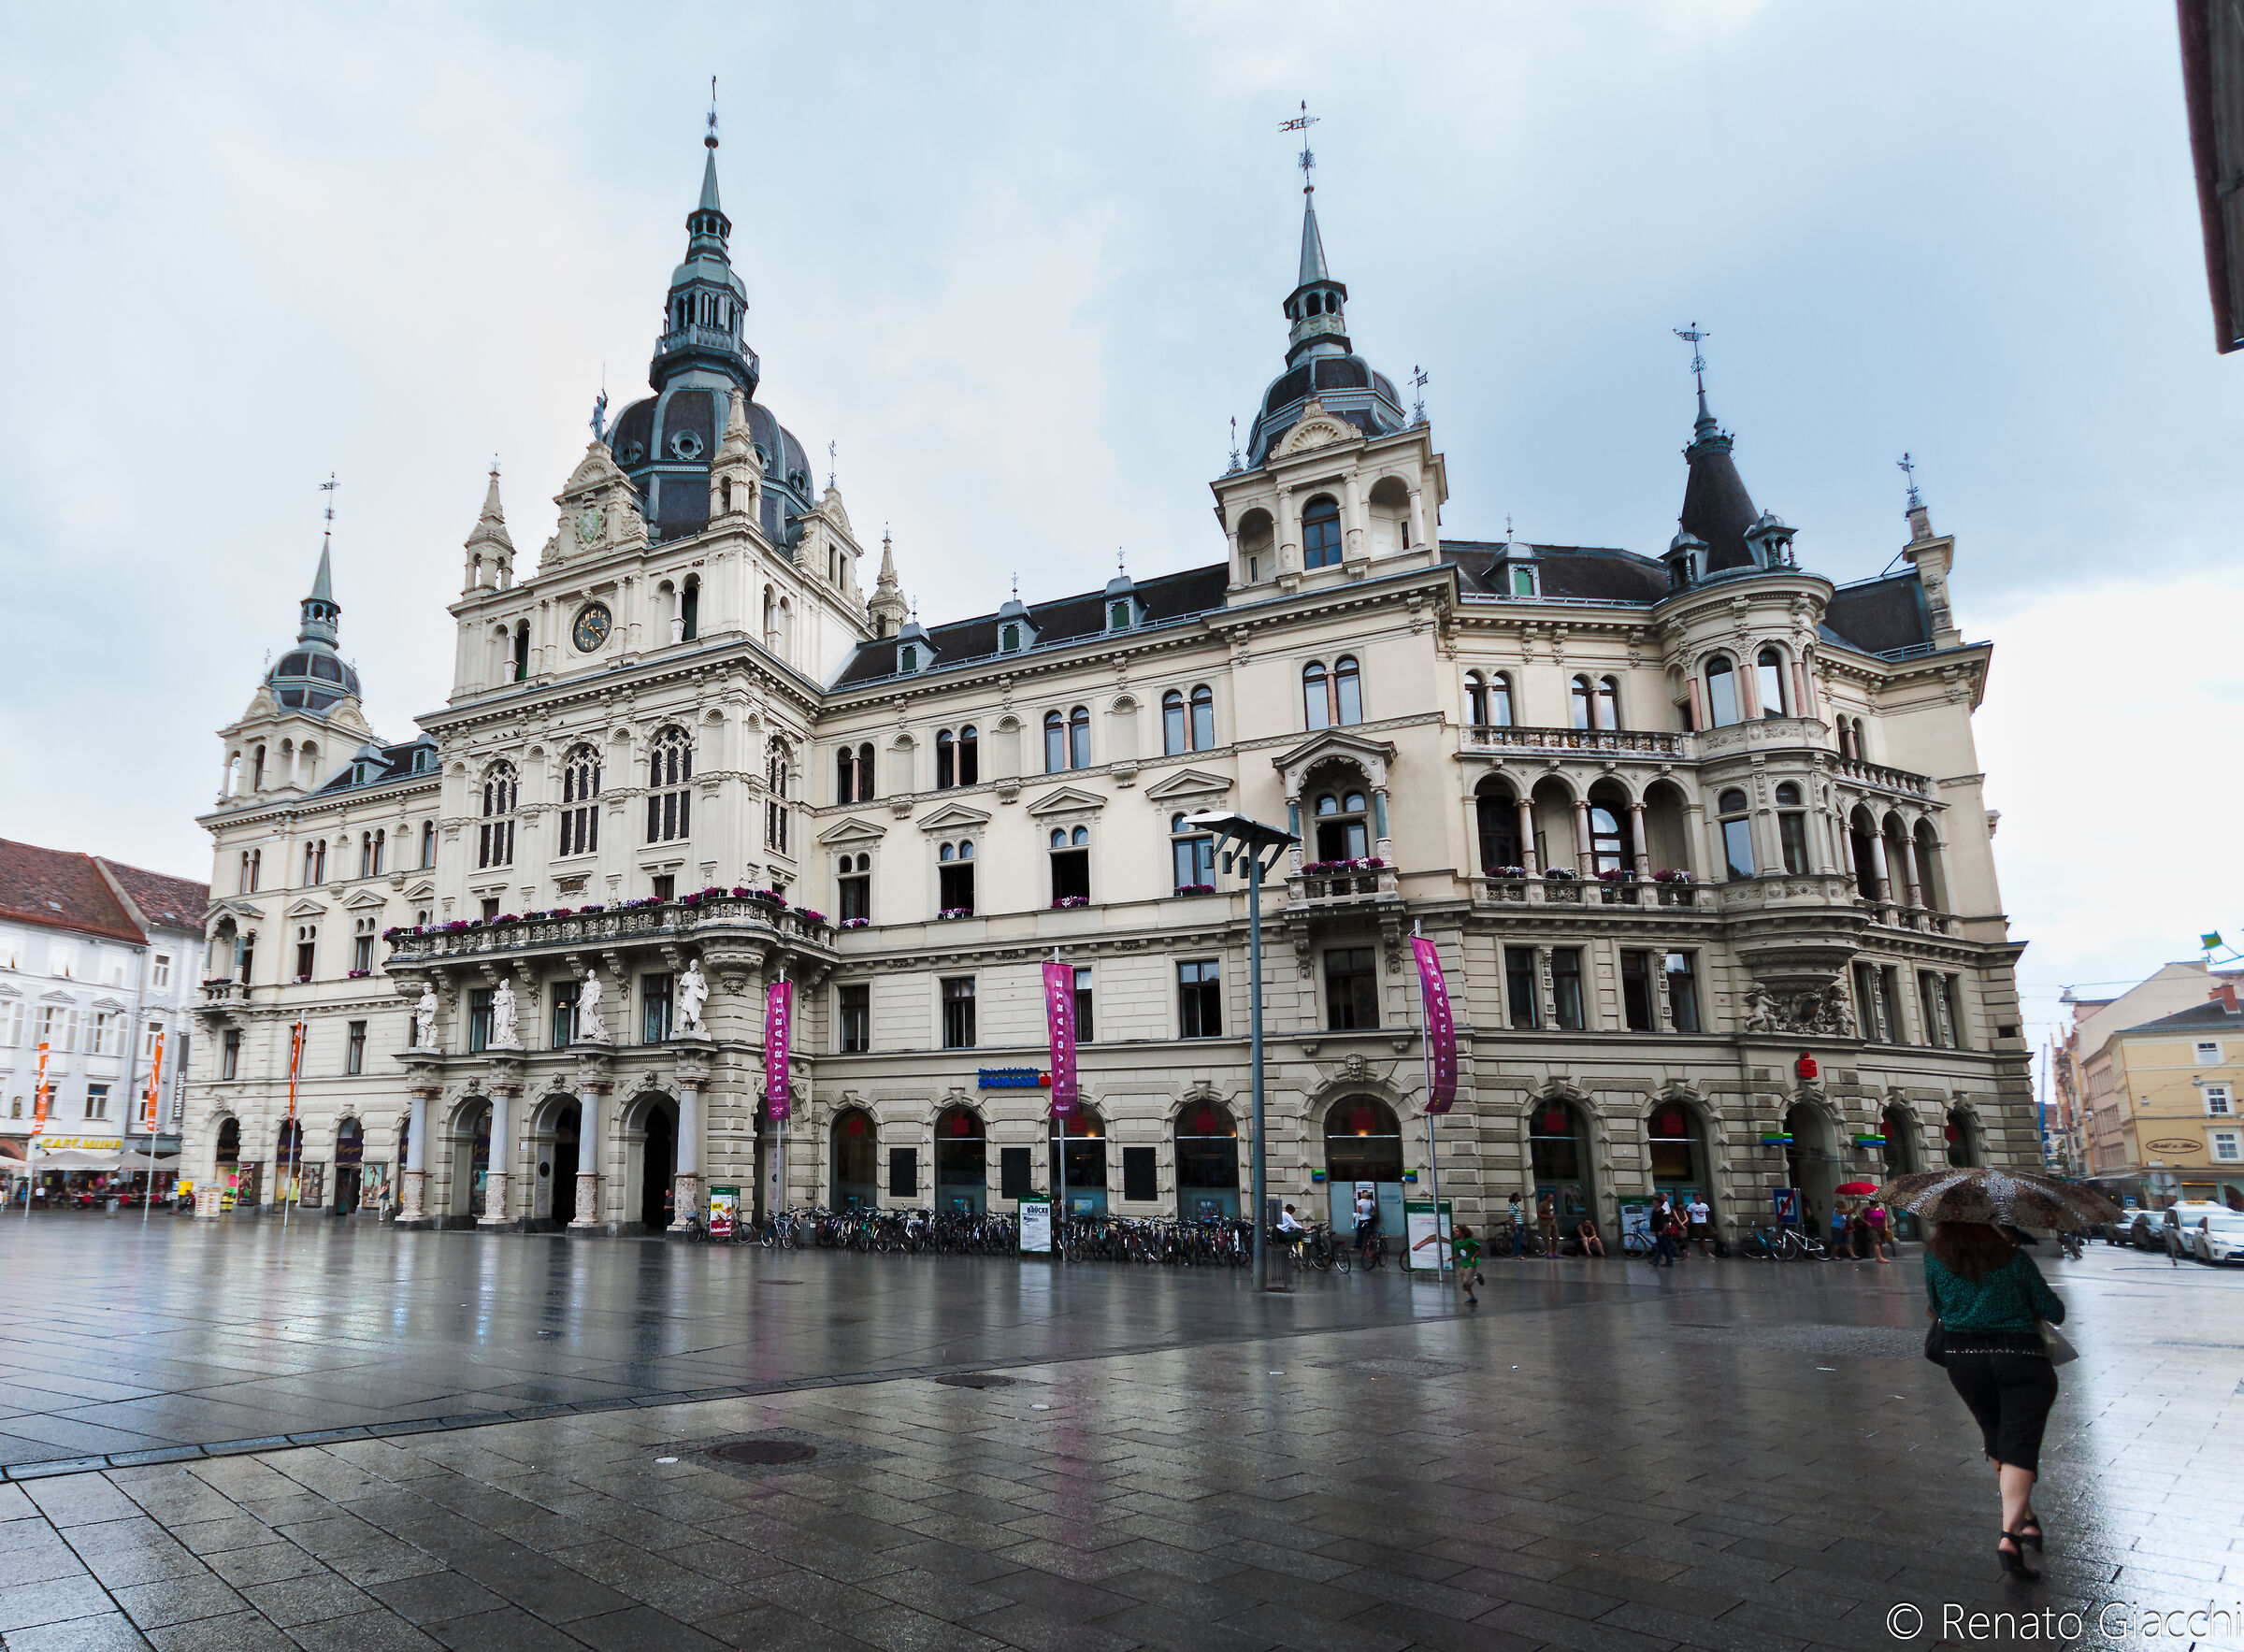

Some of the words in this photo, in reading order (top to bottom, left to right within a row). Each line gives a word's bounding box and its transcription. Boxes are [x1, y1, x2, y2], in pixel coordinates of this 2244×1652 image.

[774, 996, 784, 1092] STYRIARTE
[174, 1070, 185, 1117] HUMANIC
[978, 1076, 1040, 1088] SPARKASSE
[42, 1137, 79, 1149] CAFÉ
